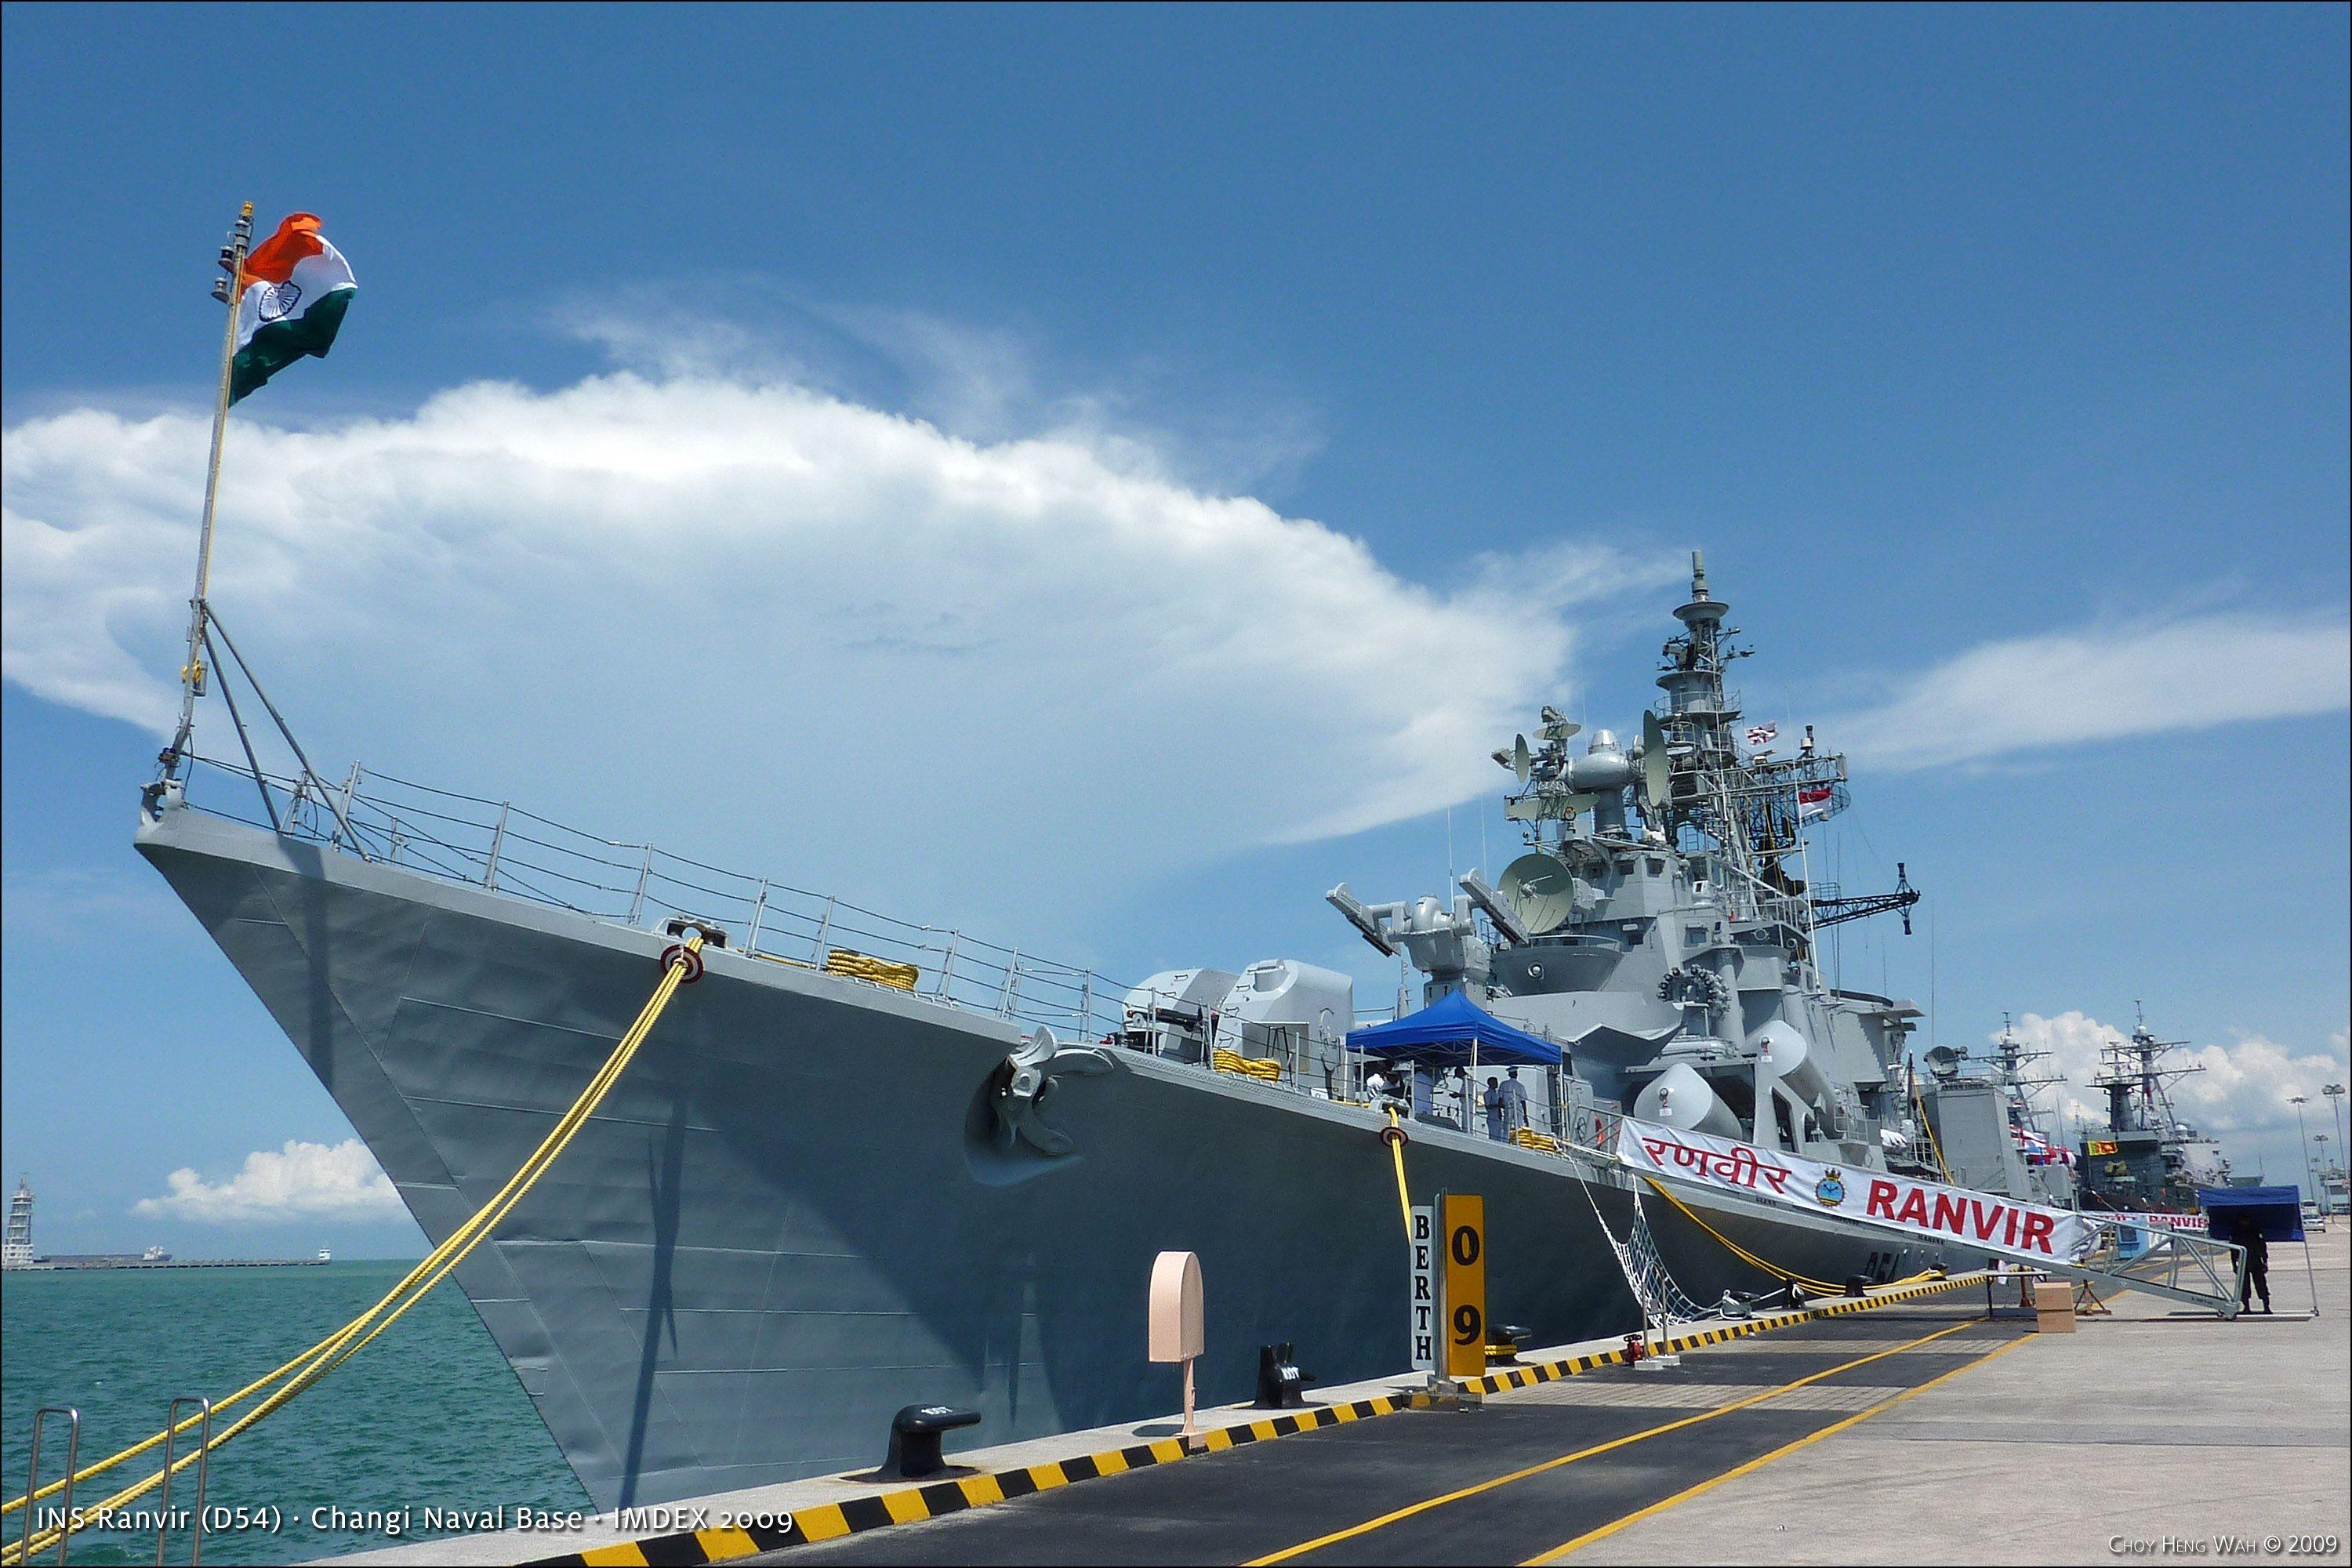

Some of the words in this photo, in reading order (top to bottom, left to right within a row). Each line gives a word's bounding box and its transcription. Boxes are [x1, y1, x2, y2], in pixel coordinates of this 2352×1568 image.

[1642, 1137, 1793, 1194] रणवीर
[1866, 1179, 2054, 1254] RANVIR
[1414, 1214, 1432, 1361] BERTH
